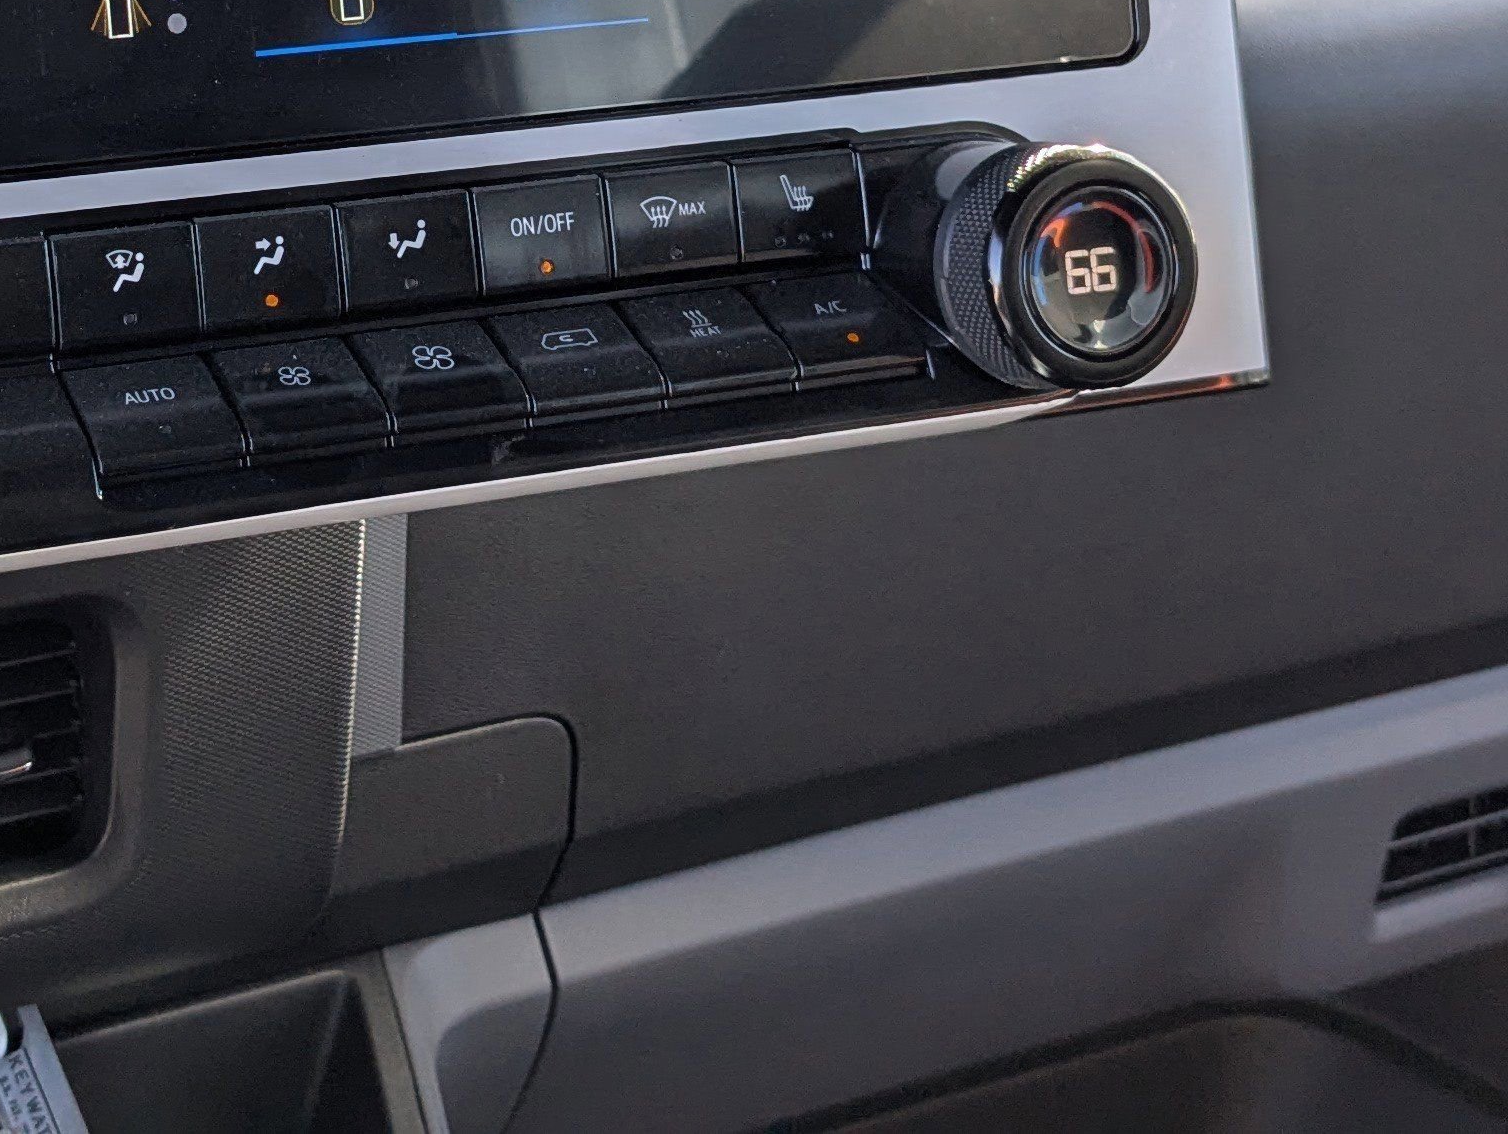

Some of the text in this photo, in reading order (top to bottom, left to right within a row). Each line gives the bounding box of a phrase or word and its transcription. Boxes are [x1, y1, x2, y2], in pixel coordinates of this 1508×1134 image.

[679, 201, 706, 215] MAX
[511, 212, 574, 237] ON/OFF
[1065, 246, 1117, 295] 66
[814, 300, 846, 315] A/C
[690, 325, 721, 337] HEAT
[126, 387, 175, 405] AUTO
